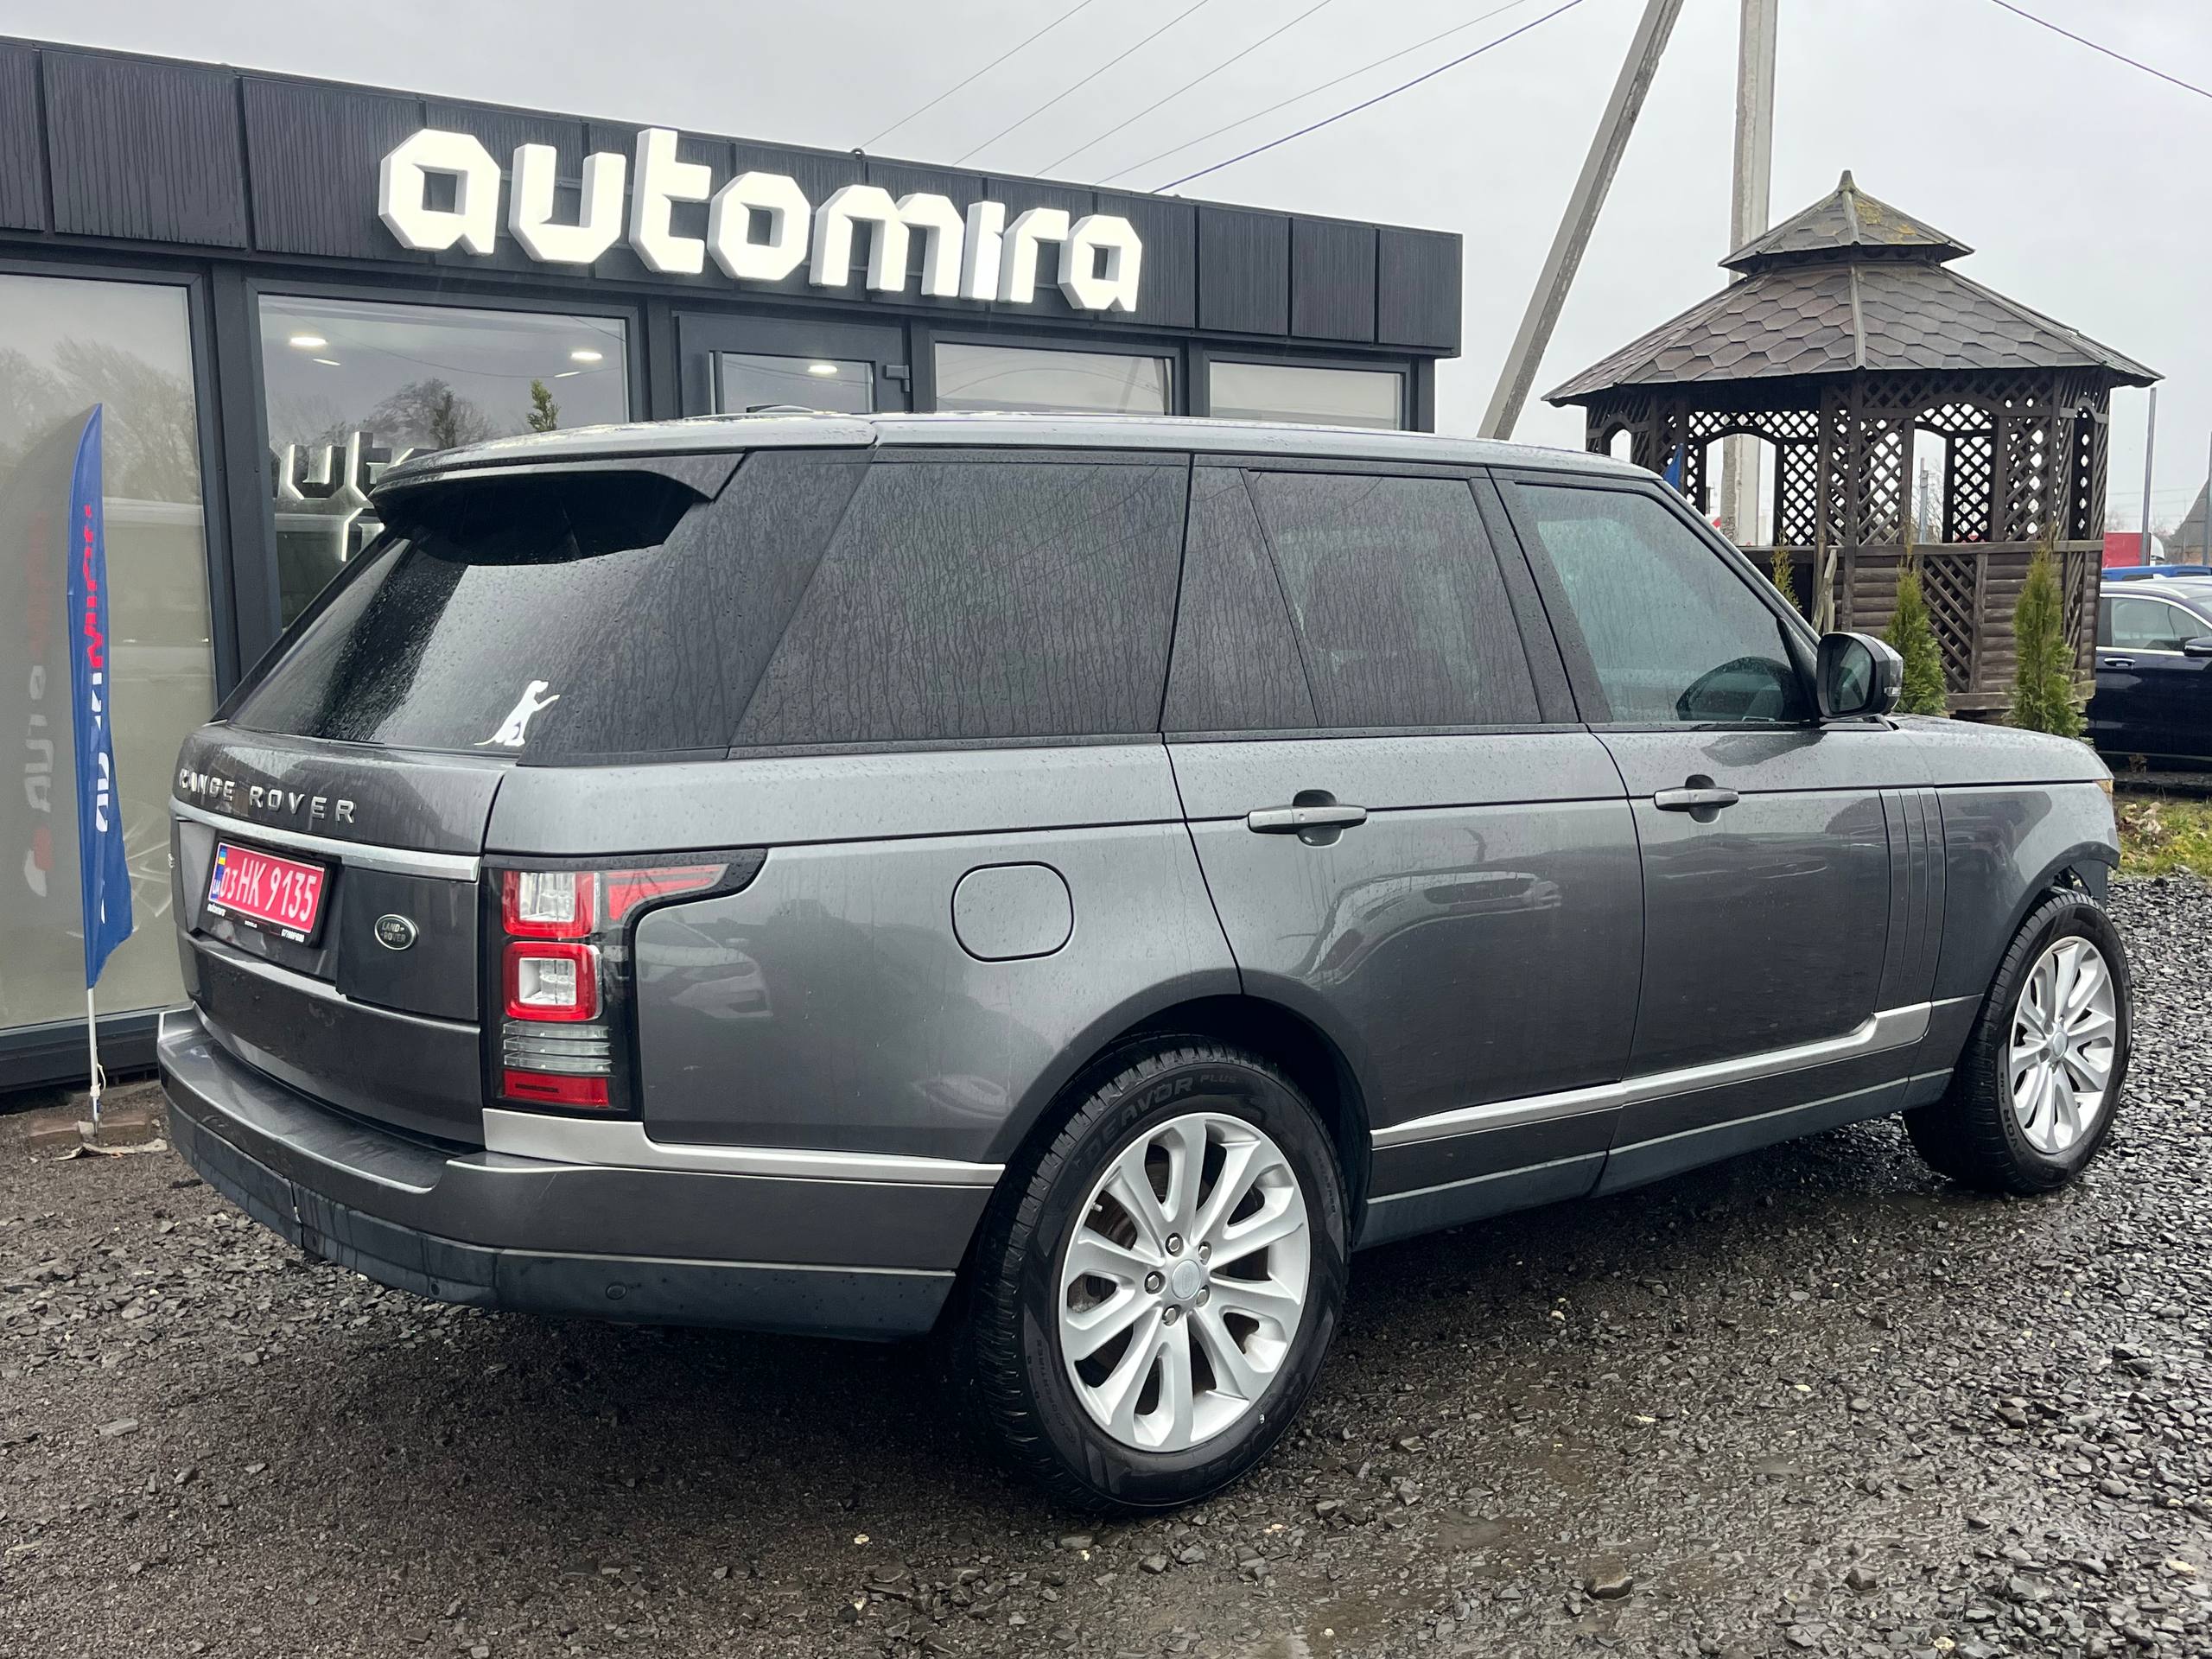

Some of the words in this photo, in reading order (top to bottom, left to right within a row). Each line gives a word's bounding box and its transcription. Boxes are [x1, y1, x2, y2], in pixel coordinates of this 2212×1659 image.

[378, 128, 1142, 313] automira
[179, 768, 235, 801] RANGE
[248, 785, 356, 823] ROVER
[264, 867, 317, 922] 9135
